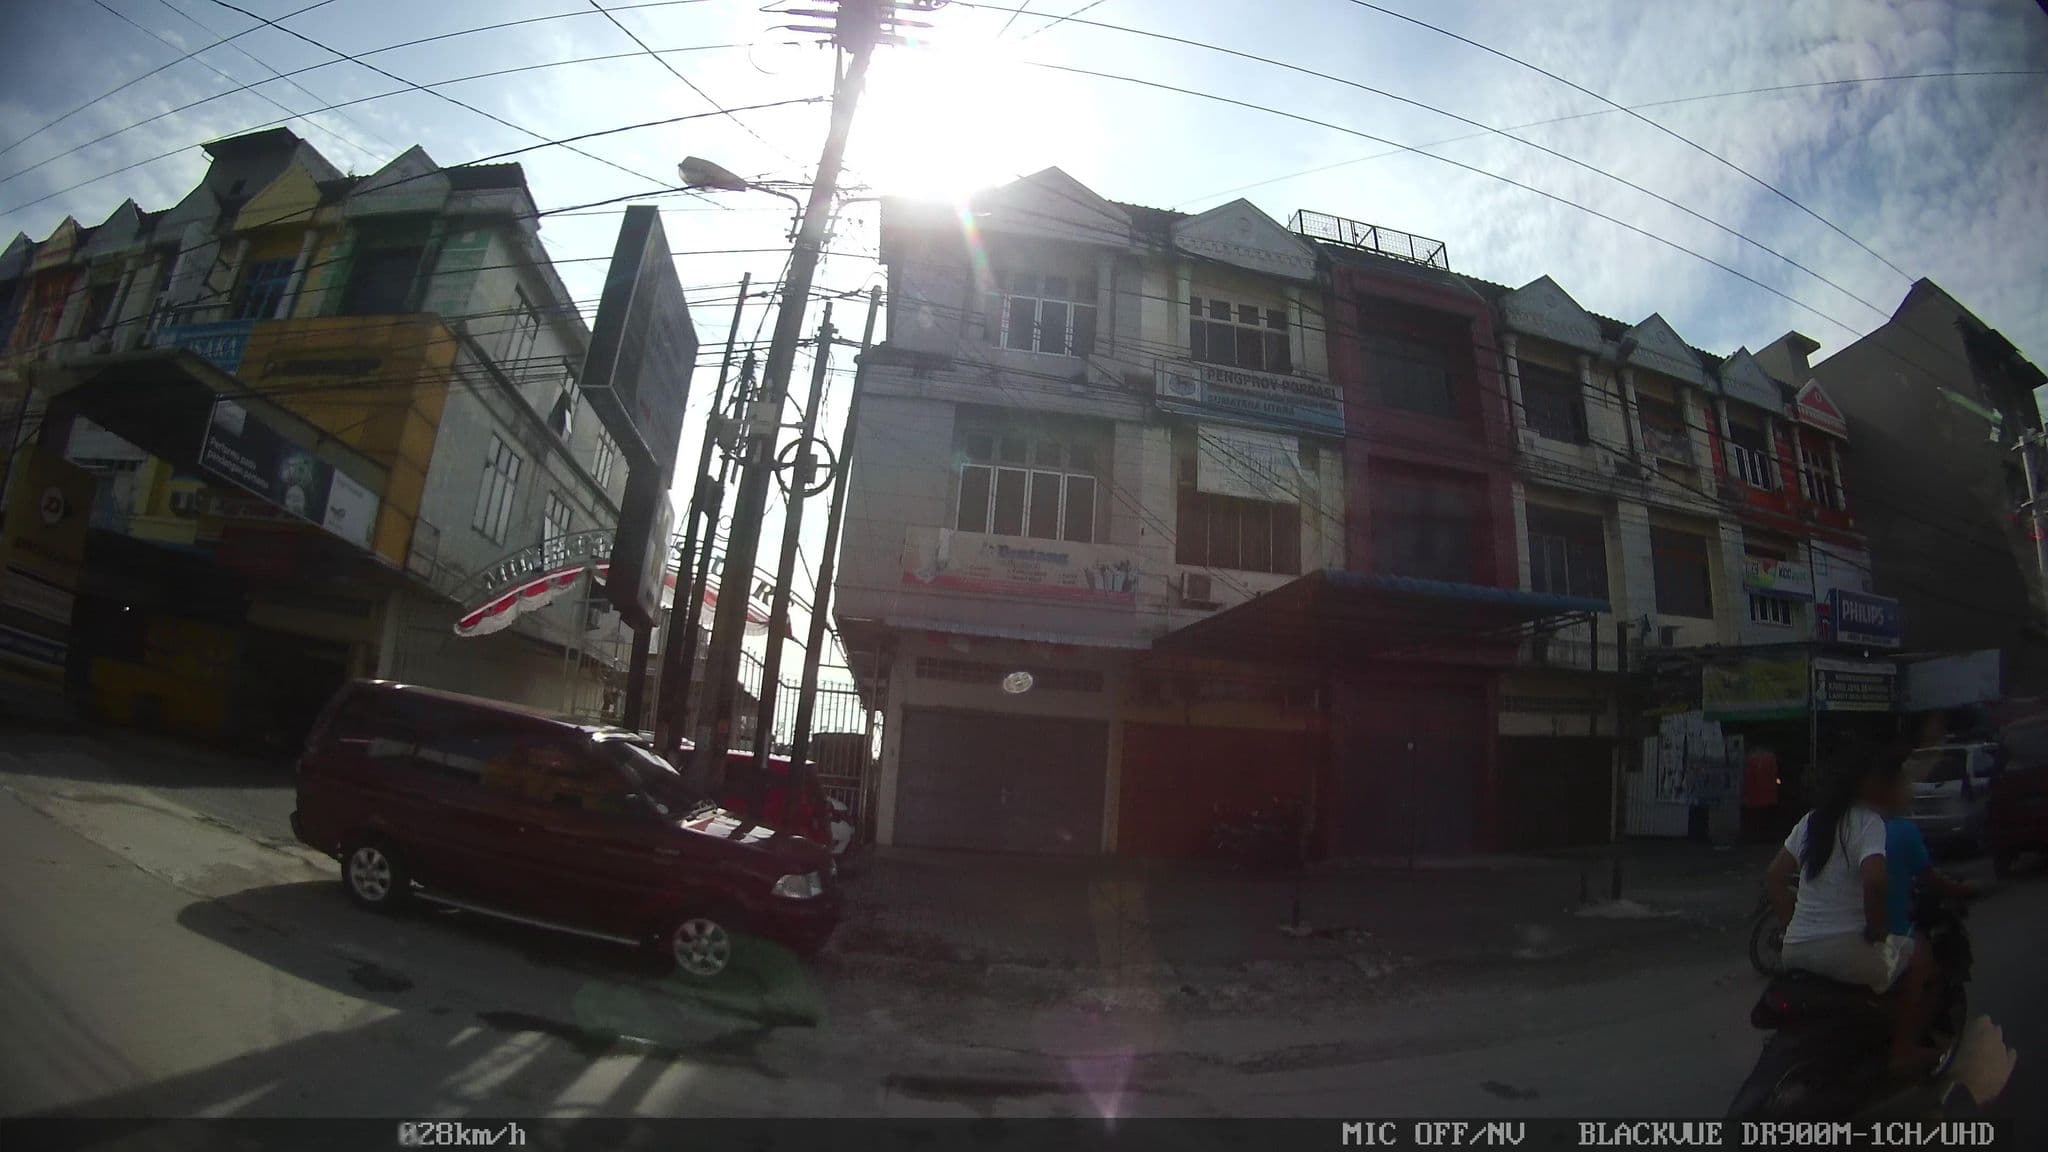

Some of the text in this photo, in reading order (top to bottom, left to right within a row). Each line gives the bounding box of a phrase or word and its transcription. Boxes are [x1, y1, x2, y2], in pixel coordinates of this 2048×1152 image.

[1206, 368, 1337, 399] PENGPROV PORDASI
[1841, 598, 1885, 625] PHILIPS
